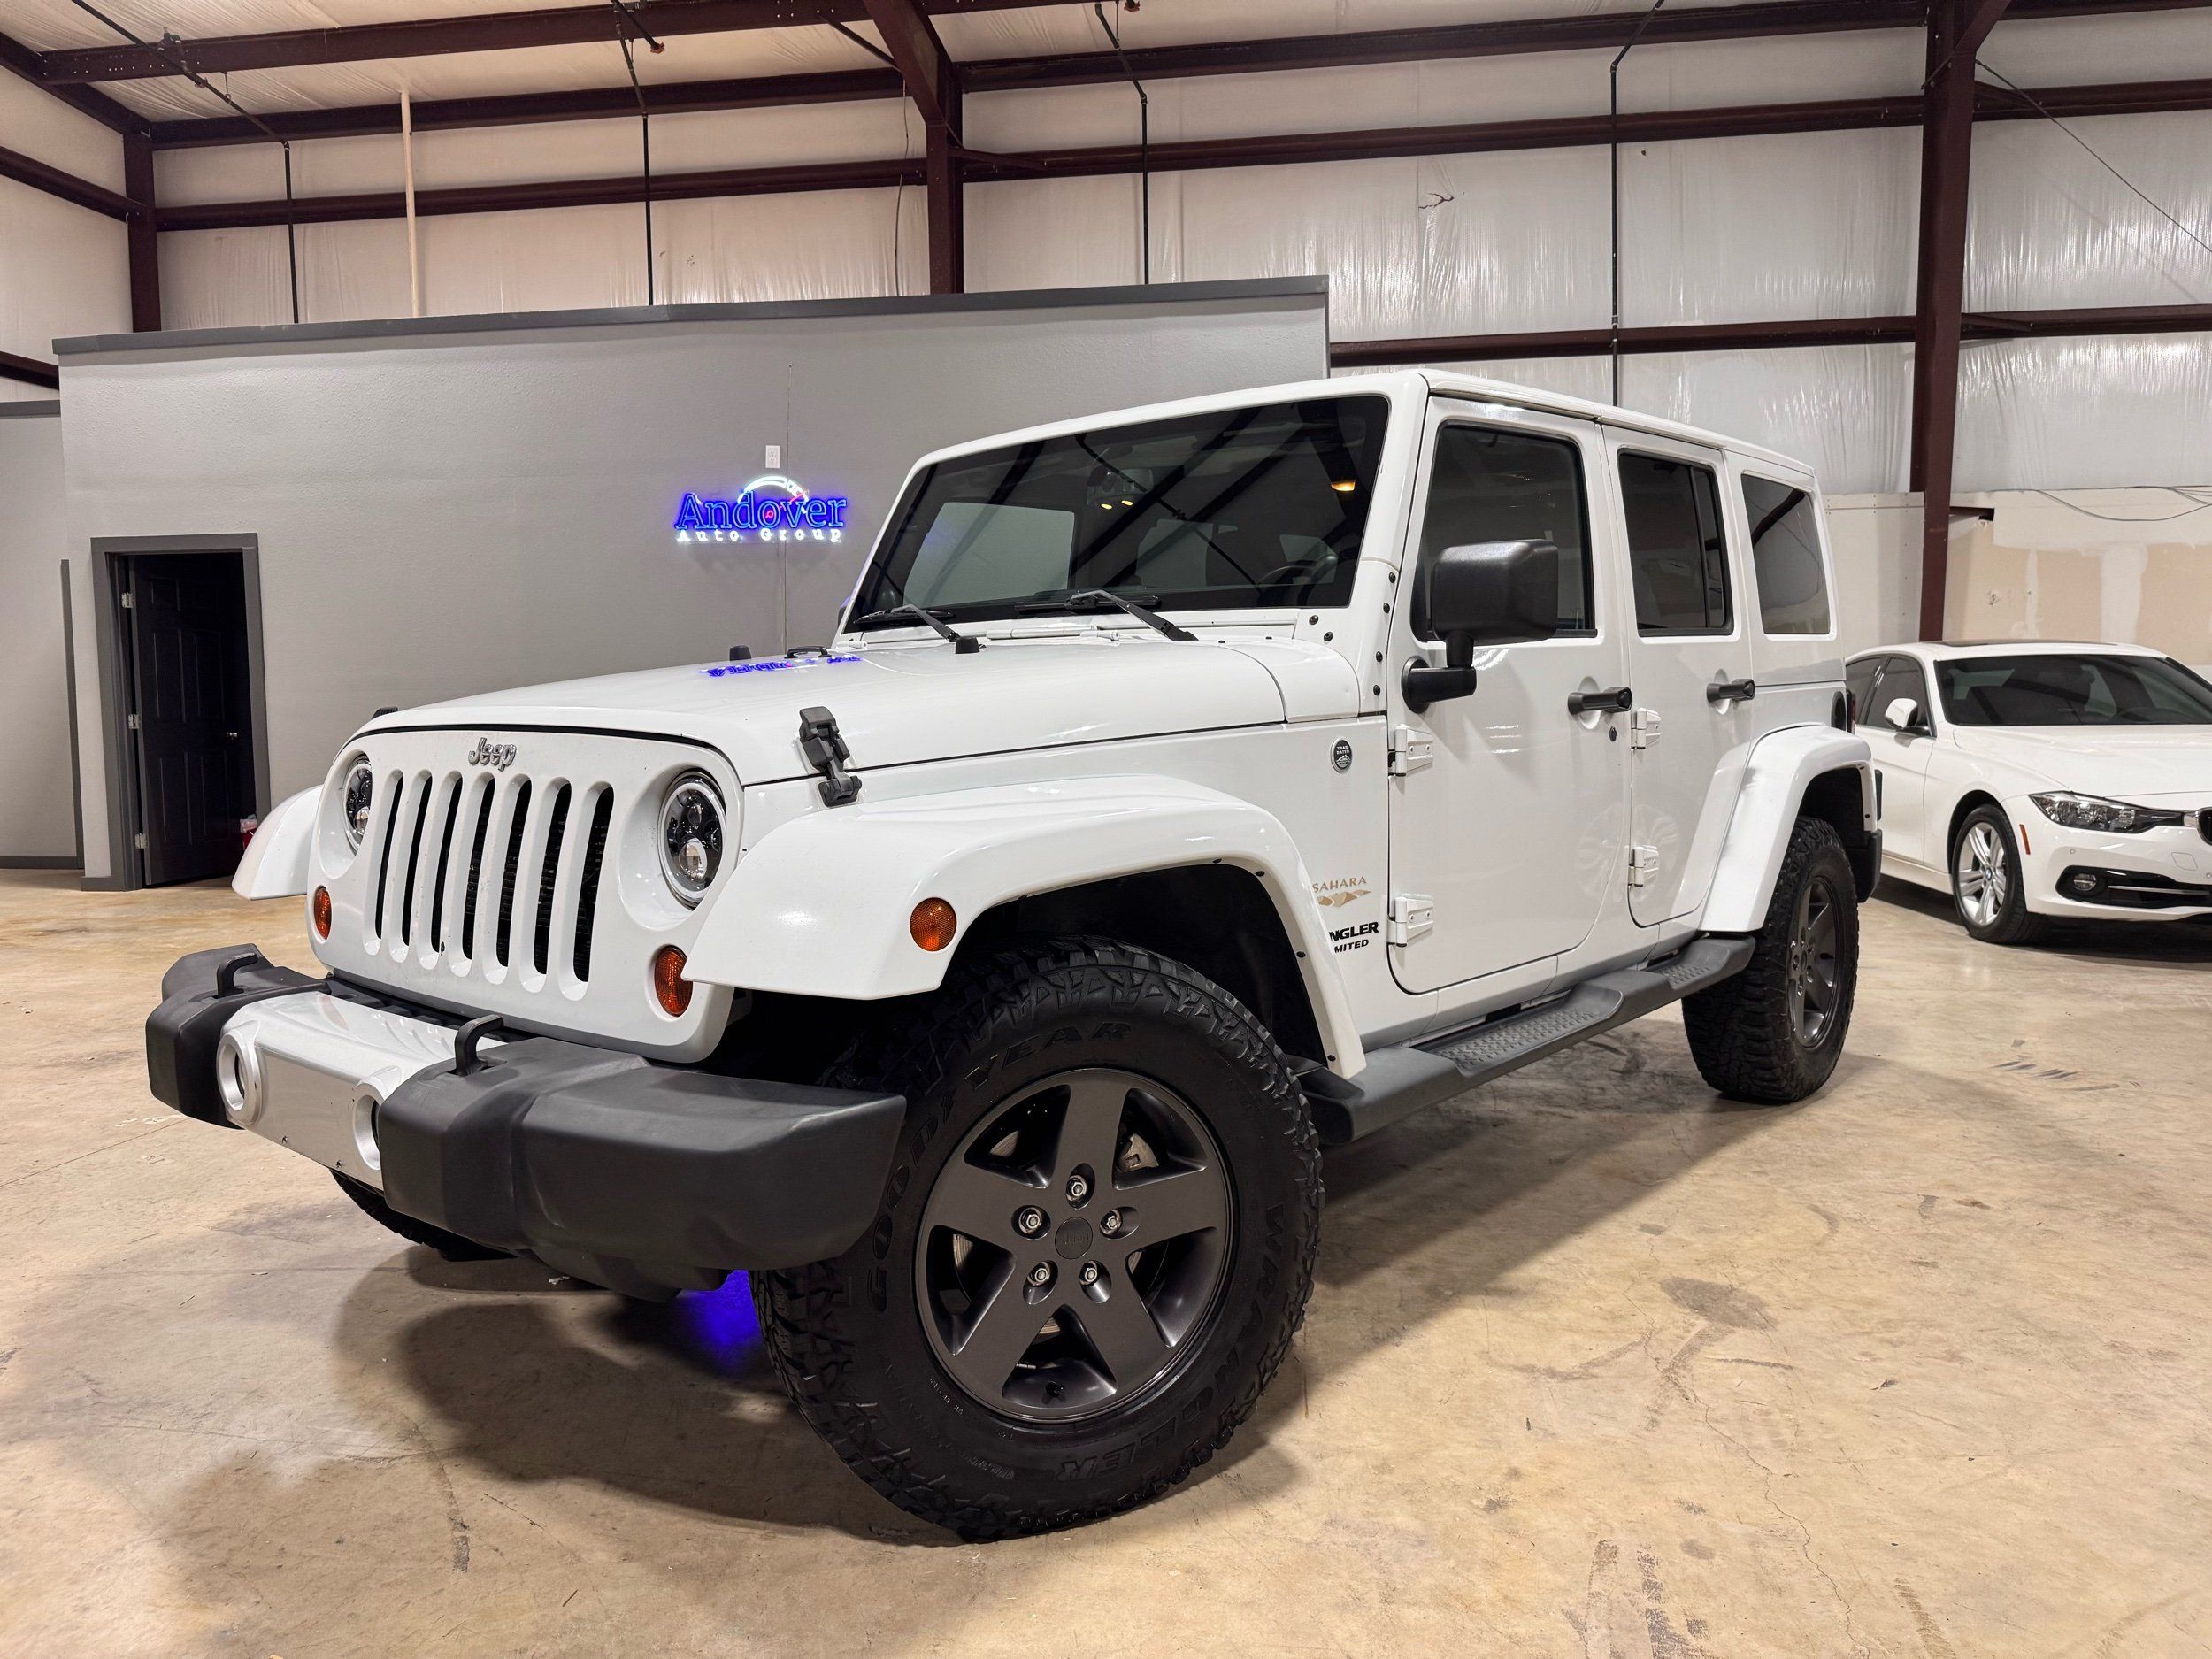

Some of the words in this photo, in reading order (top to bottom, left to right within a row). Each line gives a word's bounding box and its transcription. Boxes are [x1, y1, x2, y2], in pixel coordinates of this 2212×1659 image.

[673, 489, 848, 530] Andover
[677, 529, 741, 542] Auto
[760, 527, 841, 543] Group
[467, 736, 518, 772] Jeep
[1312, 875, 1367, 893] SAHARA
